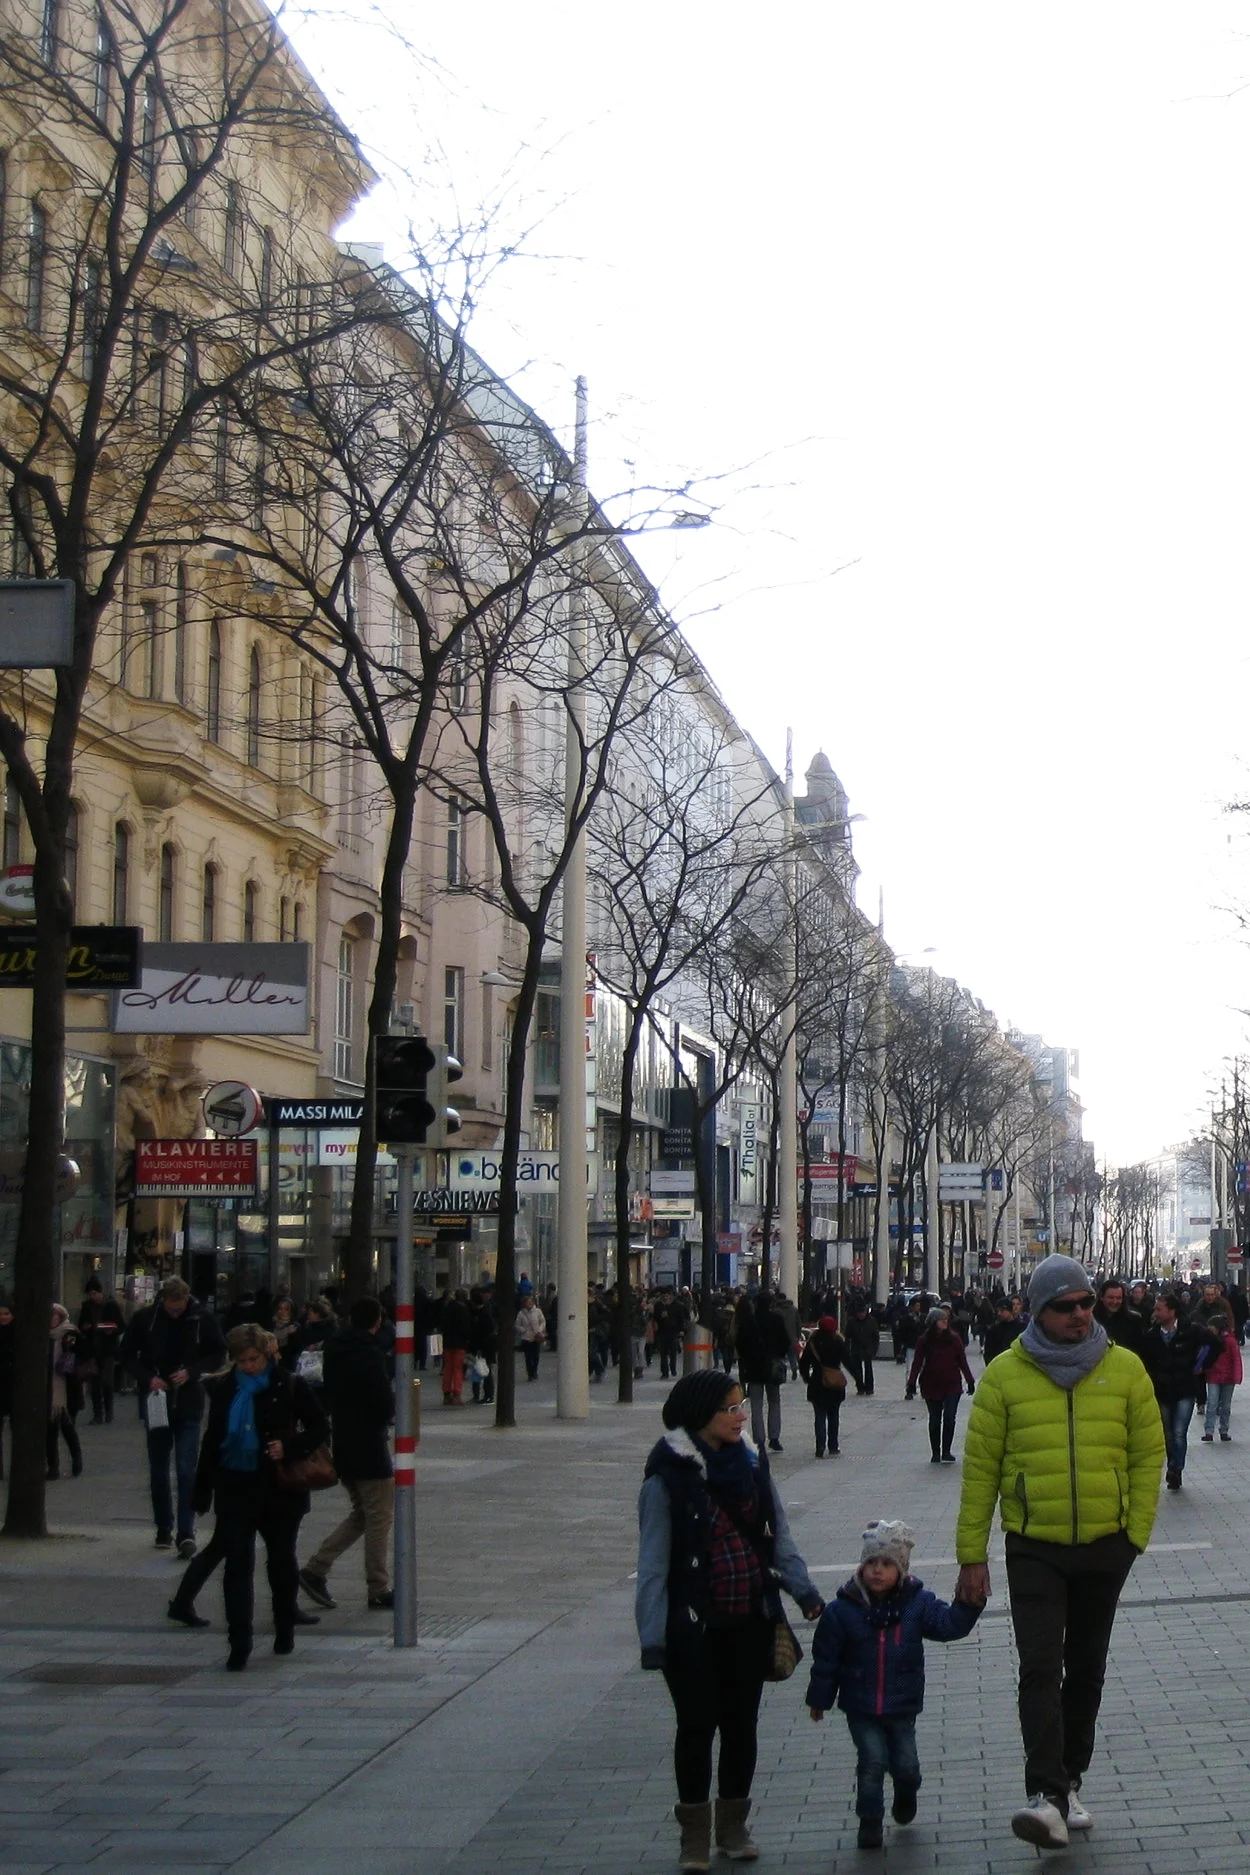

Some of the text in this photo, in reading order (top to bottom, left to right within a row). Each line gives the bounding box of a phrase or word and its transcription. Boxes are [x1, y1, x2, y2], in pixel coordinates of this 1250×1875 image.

[122, 966, 303, 1011] Miller
[280, 1106, 327, 1119] MASSI
[140, 1142, 253, 1156] KLAVIERE
[142, 1160, 250, 1169] MUSIKINSTRUMENTE
